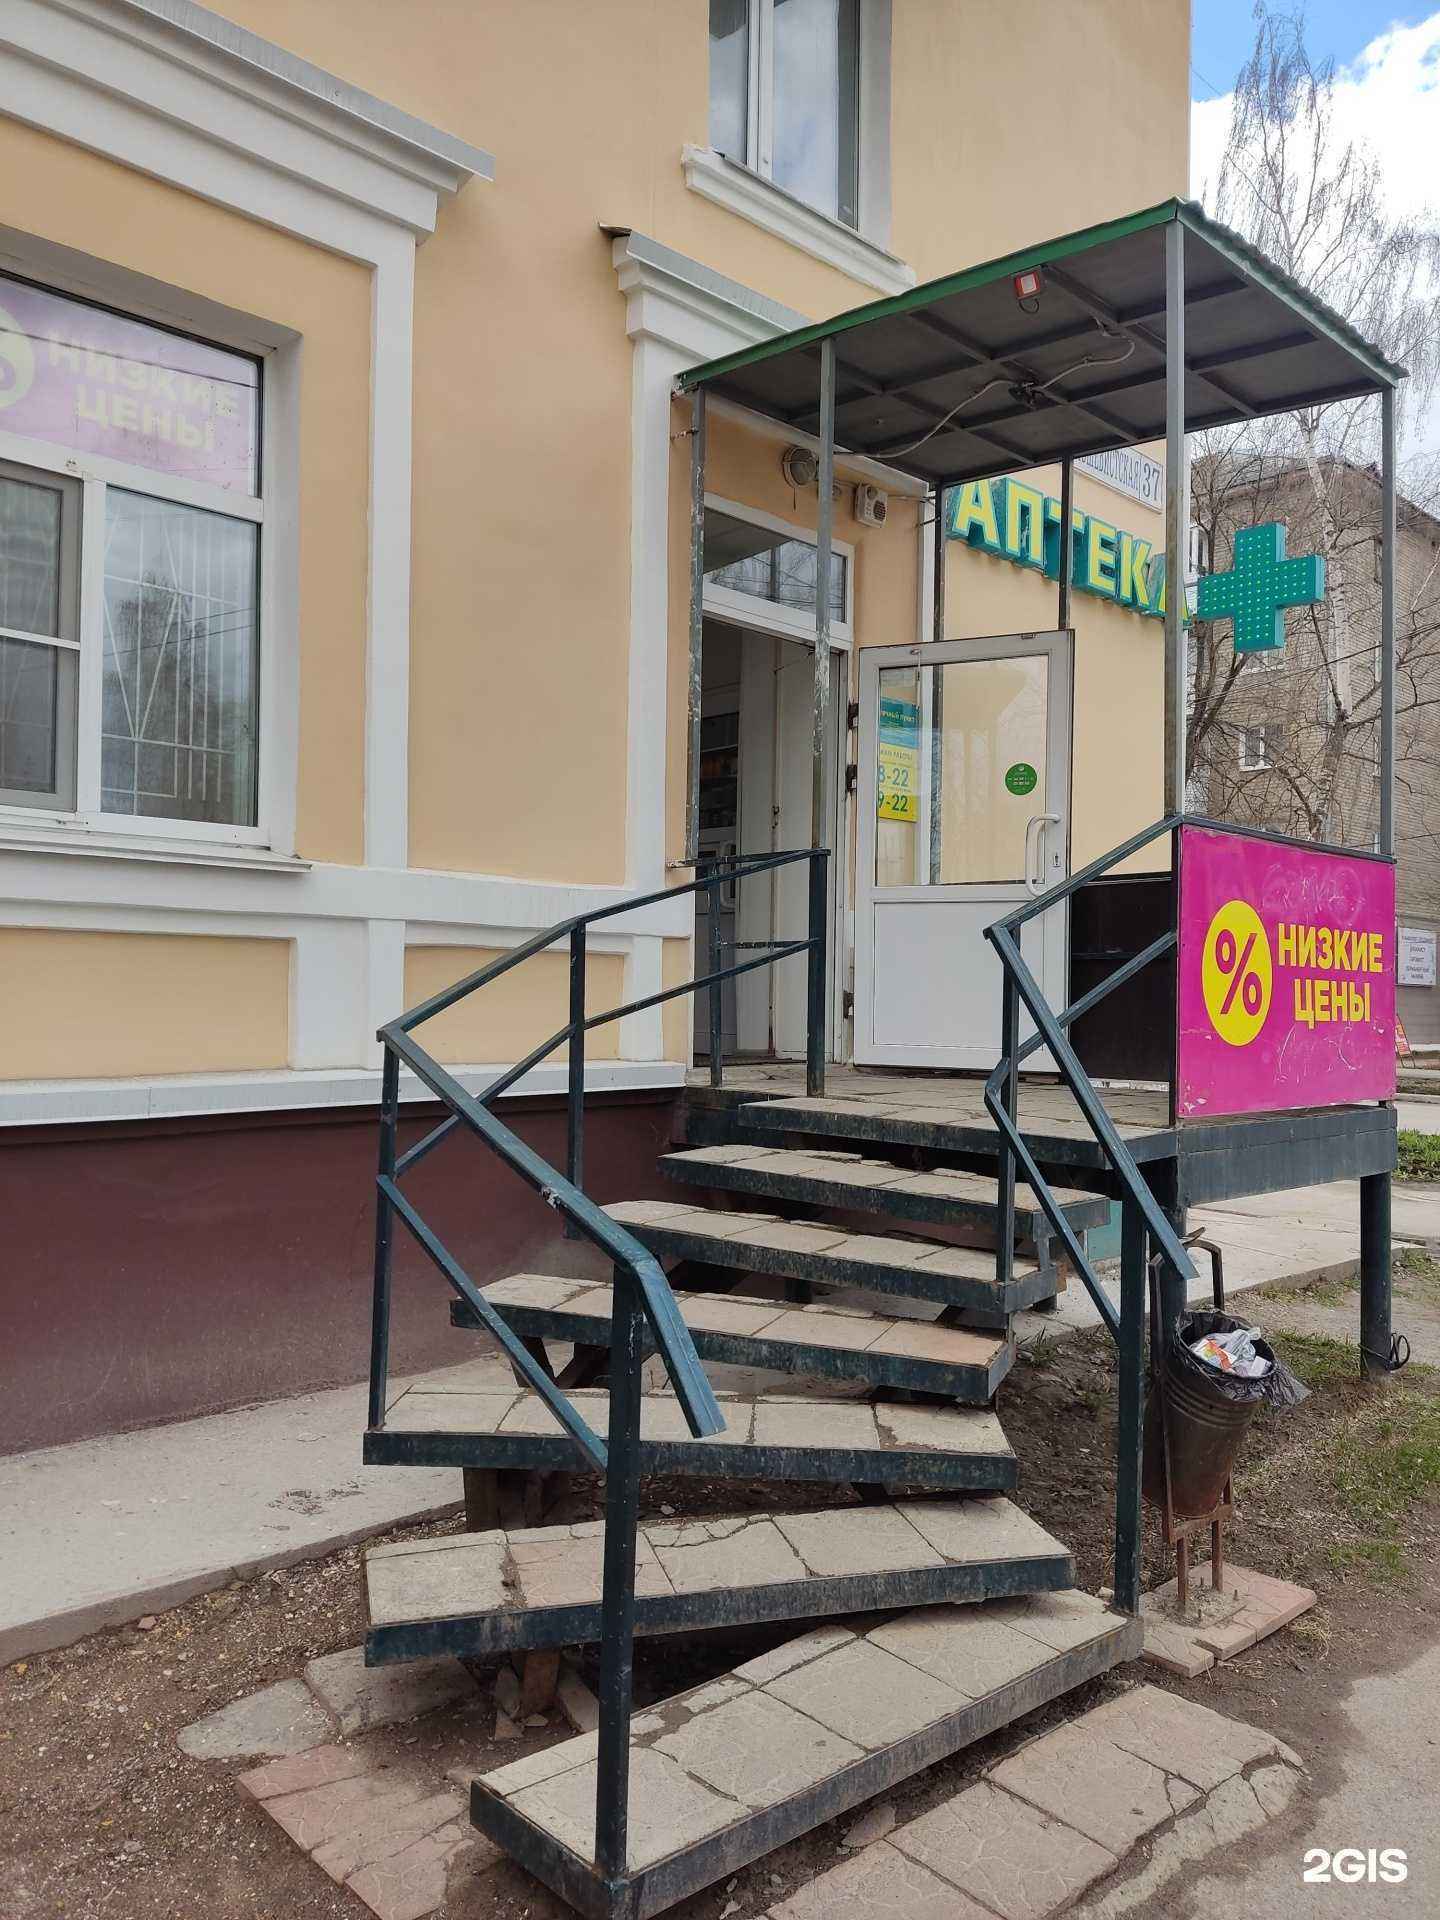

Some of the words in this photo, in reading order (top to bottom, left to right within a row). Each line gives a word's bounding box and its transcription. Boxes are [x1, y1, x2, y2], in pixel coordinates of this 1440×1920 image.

[48, 329, 239, 419] НИЗКИЕ
[77, 383, 217, 451] ЦЕНЫ
[1142, 462, 1160, 501] 37
[1278, 922, 1383, 973] НИЗКИЕ
[1294, 978, 1371, 1030] ЦЕНЫ
